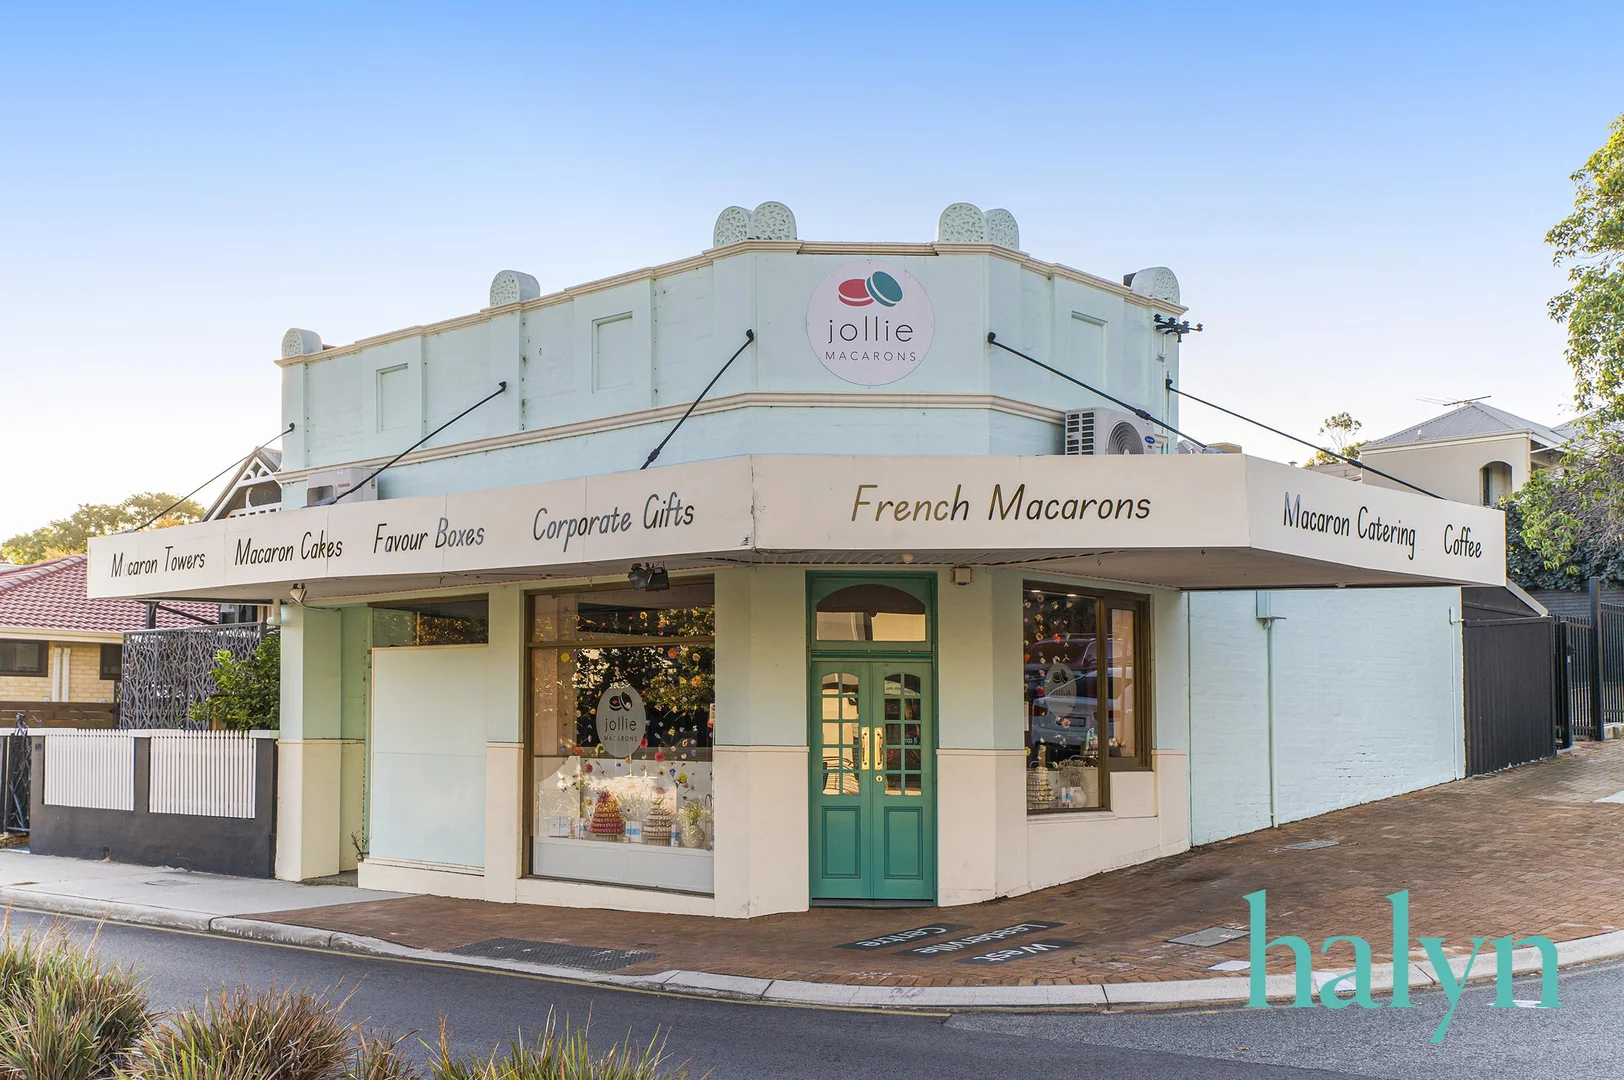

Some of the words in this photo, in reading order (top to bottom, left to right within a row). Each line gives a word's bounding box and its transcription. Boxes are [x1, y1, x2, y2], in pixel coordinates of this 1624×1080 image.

[828, 315, 914, 344] jollie
[825, 350, 916, 362] MACARONS
[851, 483, 970, 522] French
[988, 483, 1151, 521] Macarons
[373, 523, 429, 553] Favour
[435, 517, 485, 548] Boxes
[533, 507, 632, 552] Corporate
[643, 491, 695, 529] Gifts
[1283, 491, 1350, 536] Macaron
[1357, 506, 1416, 560] Catering
[234, 538, 294, 566] Macaron
[300, 530, 343, 560] Cakes
[1443, 523, 1483, 559] Coffee
[164, 546, 205, 572] Towers
[605, 716, 637, 732] jollie
[855, 926, 947, 946] Centre
[912, 923, 1048, 955] Leederville
[972, 942, 1061, 963] West
